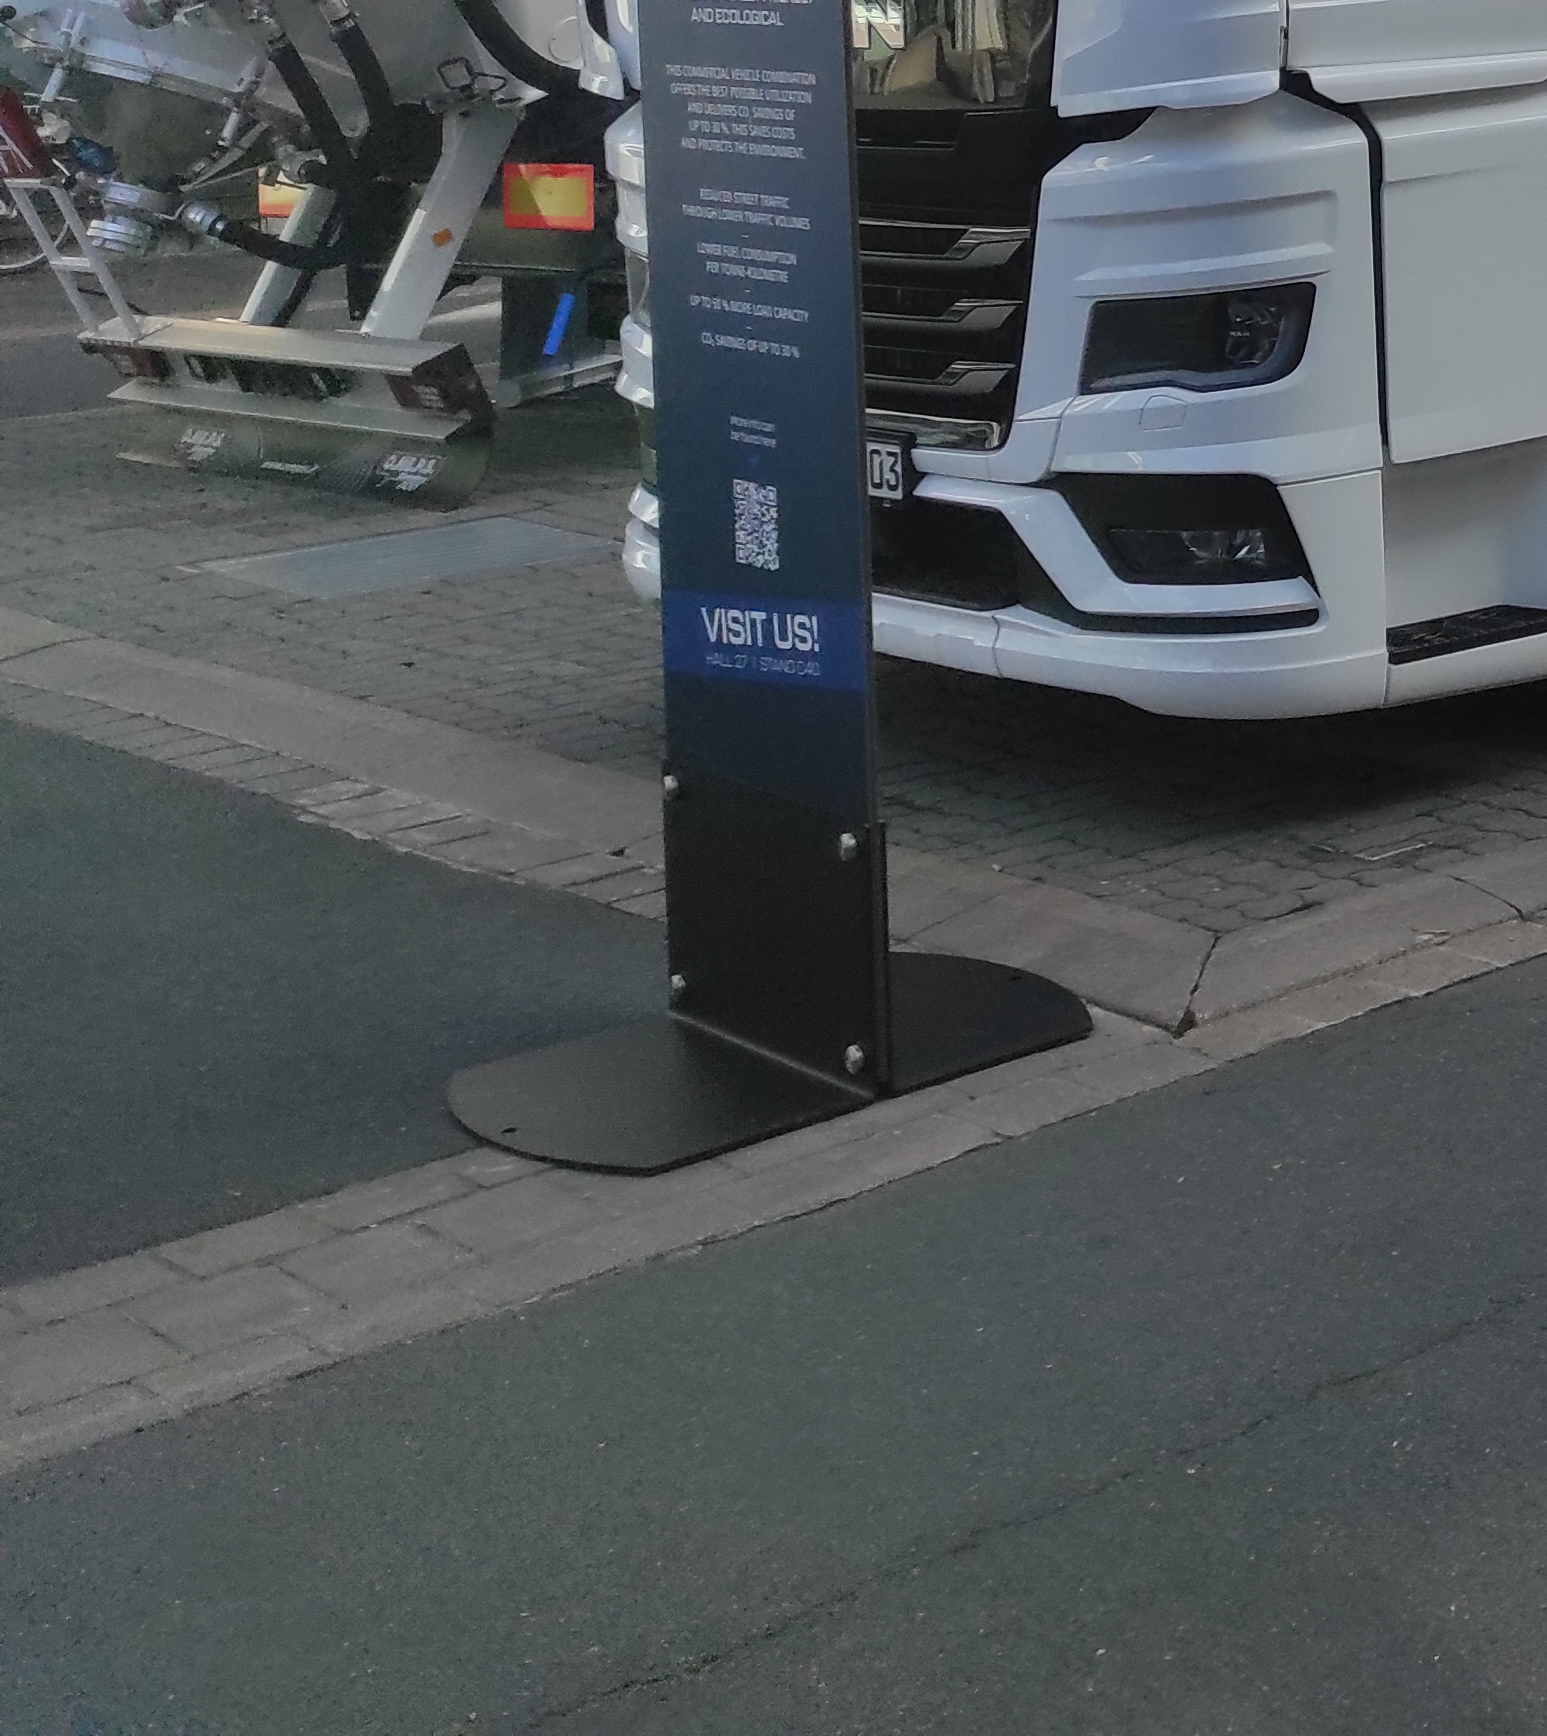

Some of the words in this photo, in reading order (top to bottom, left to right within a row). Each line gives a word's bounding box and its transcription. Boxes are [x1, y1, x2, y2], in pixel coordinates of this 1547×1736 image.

[691, 7, 714, 24] AND
[716, 9, 785, 26] ECOLOGICAL
[701, 606, 768, 647] VISIT
[772, 613, 821, 653] US!
